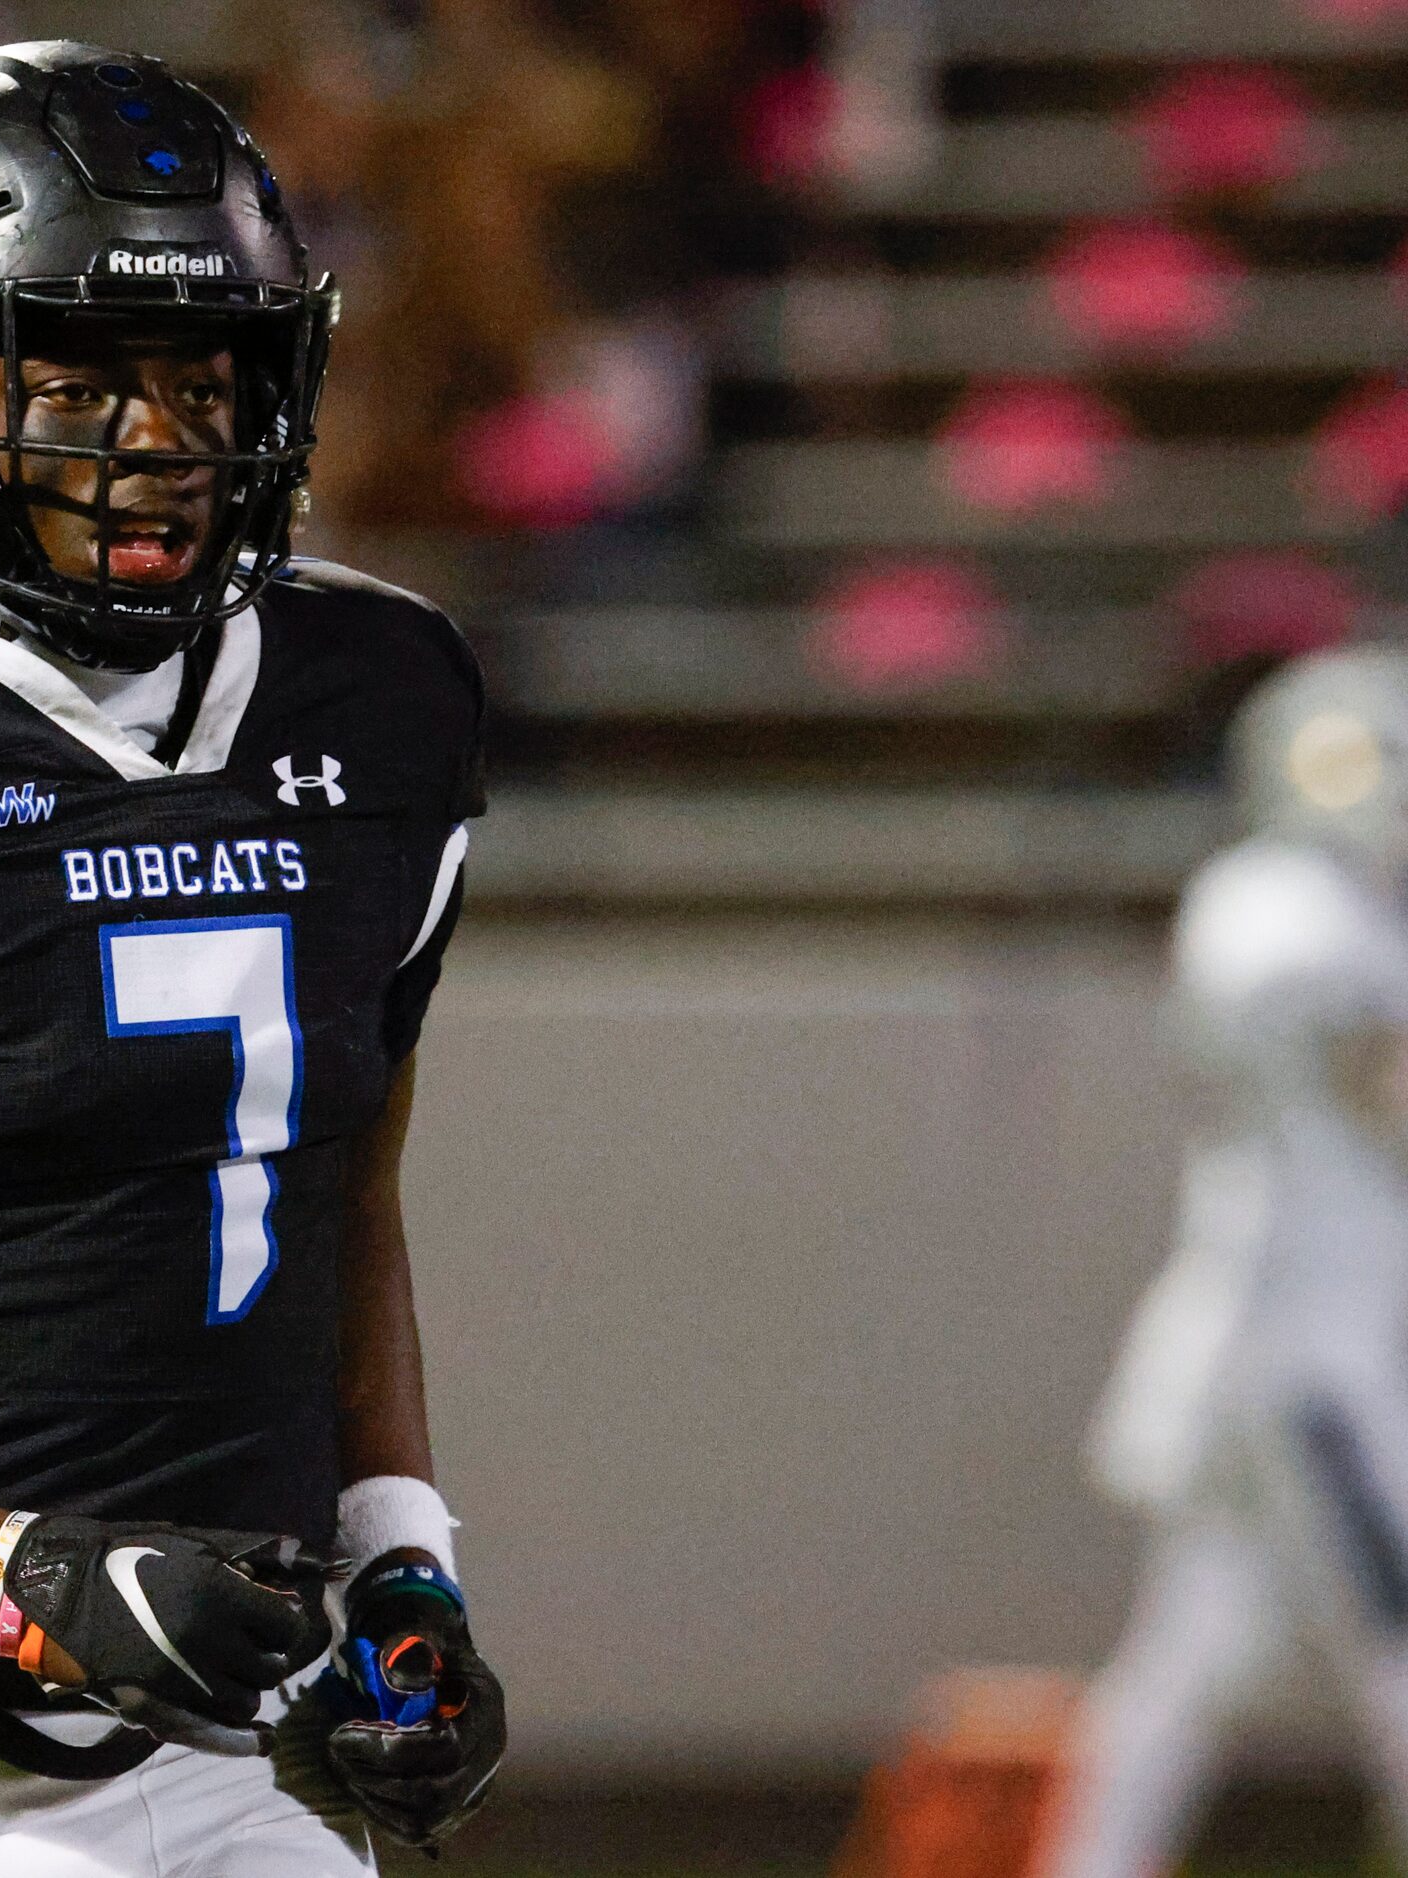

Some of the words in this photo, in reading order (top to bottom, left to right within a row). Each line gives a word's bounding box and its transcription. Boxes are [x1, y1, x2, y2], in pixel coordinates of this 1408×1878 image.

[109, 250, 224, 276] Riddell
[62, 839, 308, 901] BOBCATS
[99, 914, 304, 1326] 7
